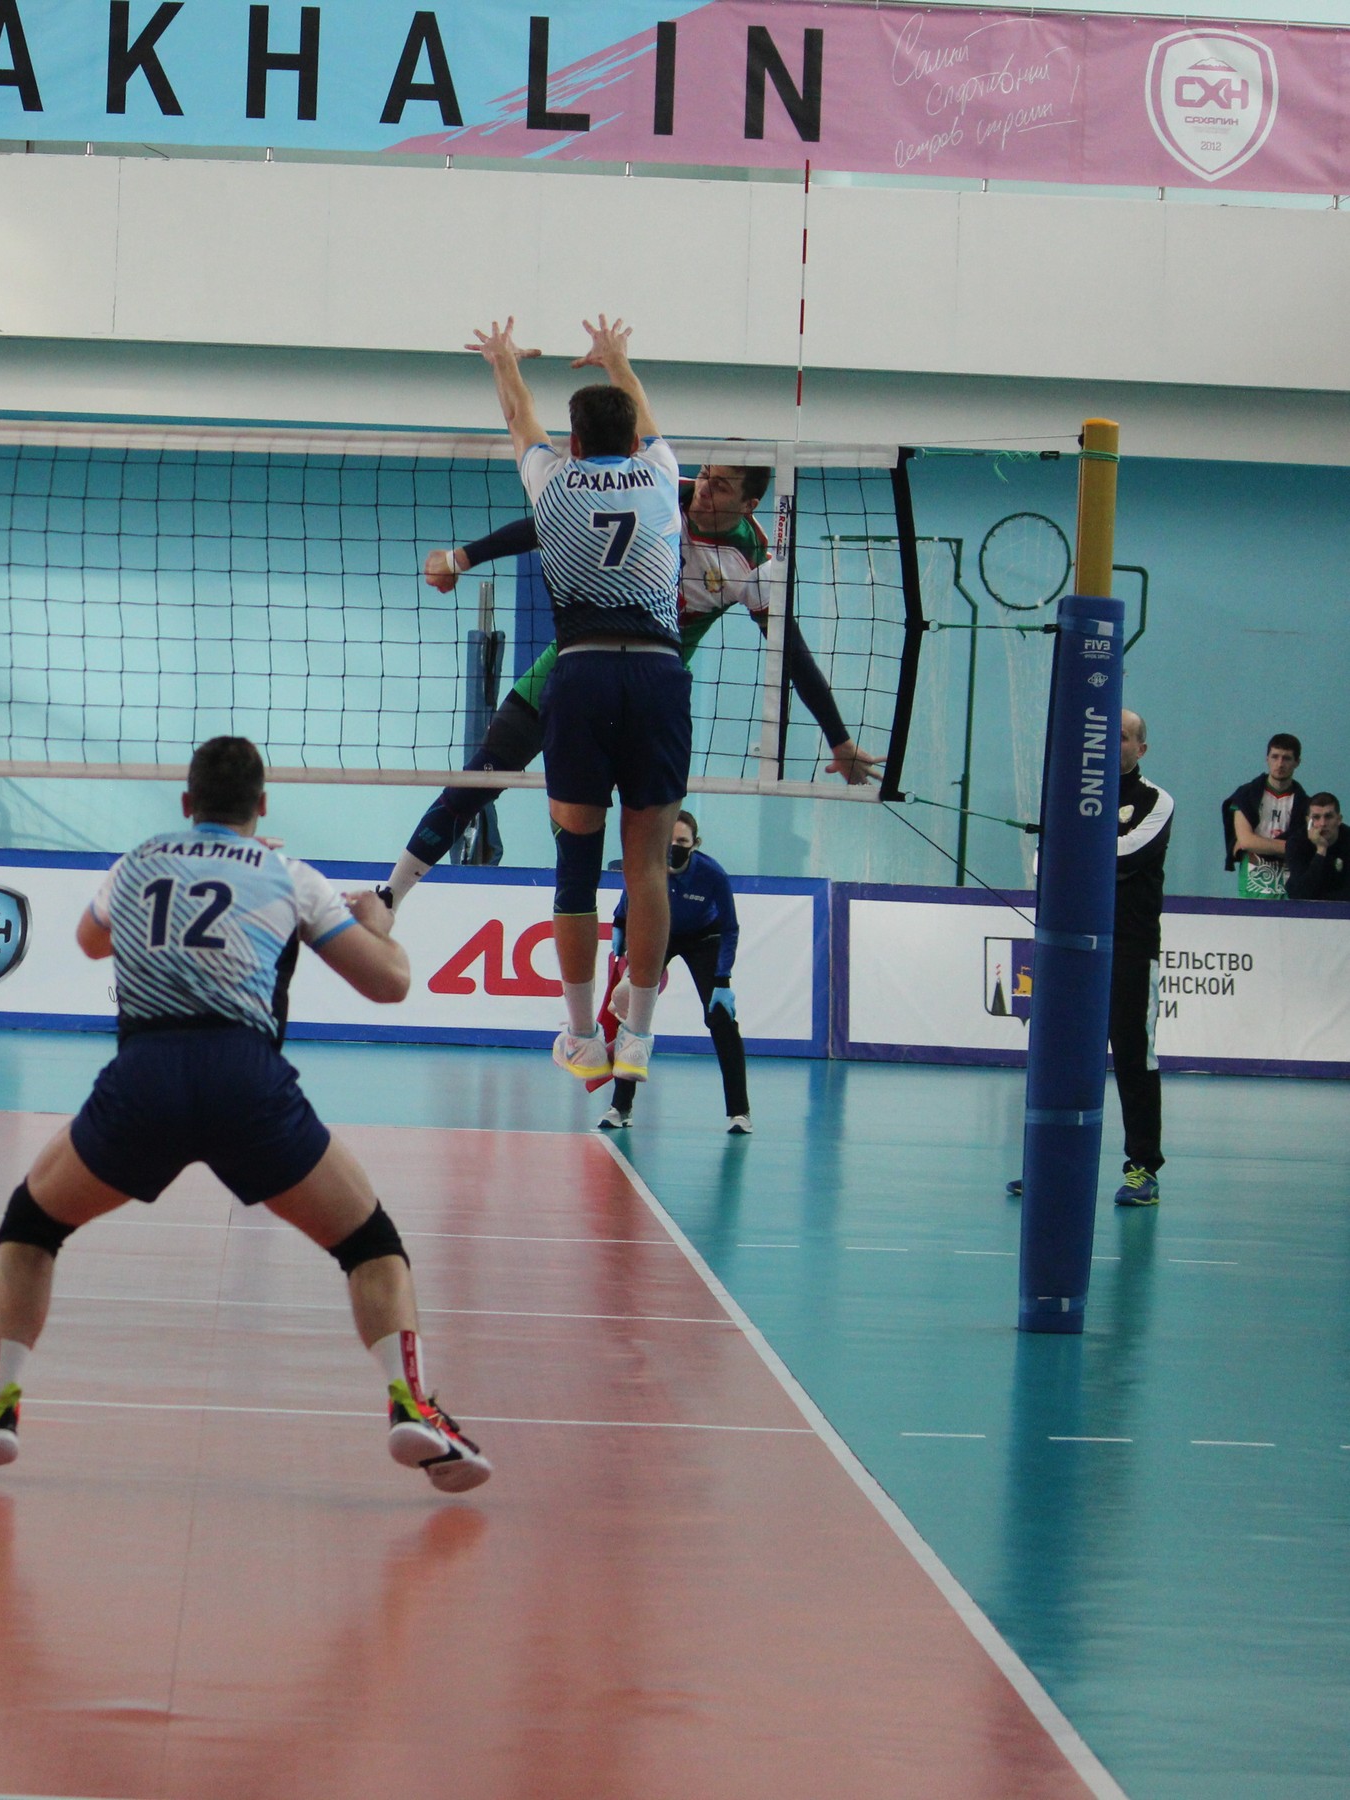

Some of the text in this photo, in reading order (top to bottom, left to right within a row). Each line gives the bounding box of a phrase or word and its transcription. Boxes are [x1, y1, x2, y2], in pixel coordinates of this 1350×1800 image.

[1200, 140, 1222, 151] 2012
[566, 469, 654, 492] САХАЛИН
[593, 511, 637, 567] 7
[1079, 706, 1108, 817] JINLING
[143, 877, 233, 949] 12
[1159, 951, 1253, 971] ТЕЛЬСТВО
[1159, 973, 1234, 996] ИНСКОЙ
